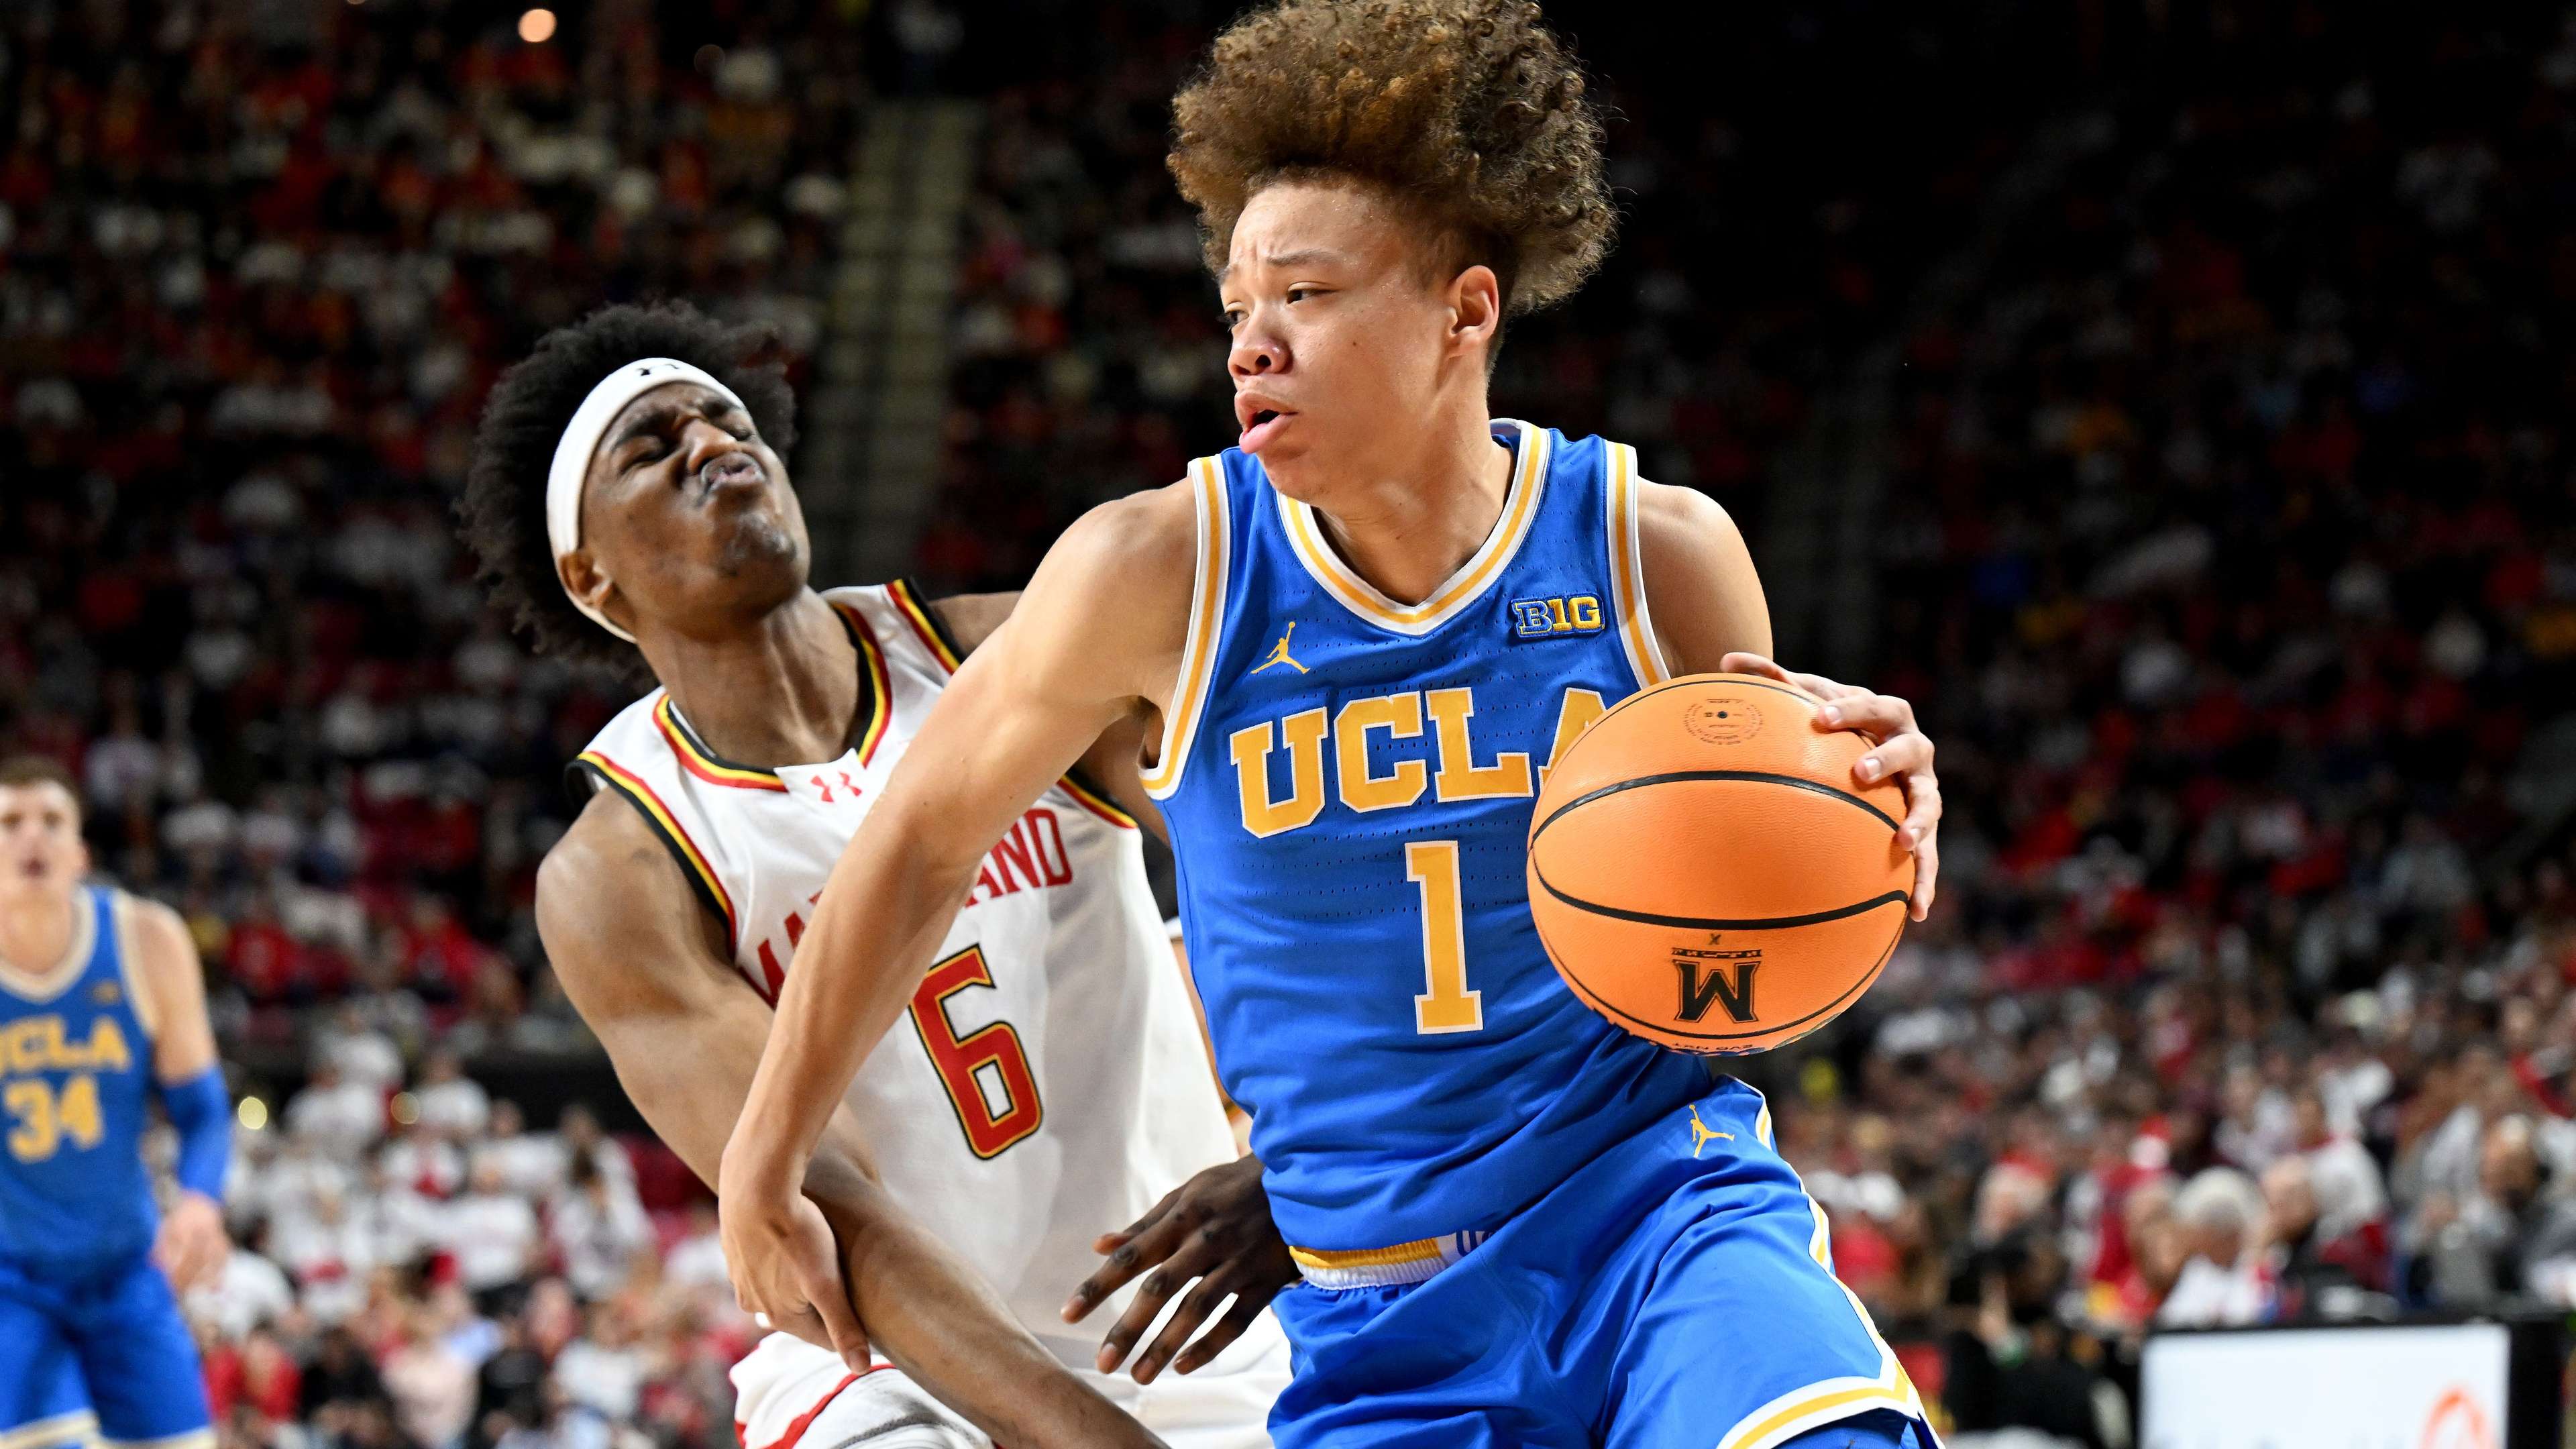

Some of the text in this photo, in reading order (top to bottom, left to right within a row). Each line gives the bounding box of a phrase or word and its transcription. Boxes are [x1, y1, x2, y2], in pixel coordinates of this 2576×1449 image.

[1405, 841, 1483, 1034] 1
[1672, 959, 1761, 1024] M
[0, 1015, 132, 1074] CLA
[908, 943, 1042, 1161] 6
[4, 1073, 104, 1163] 34
